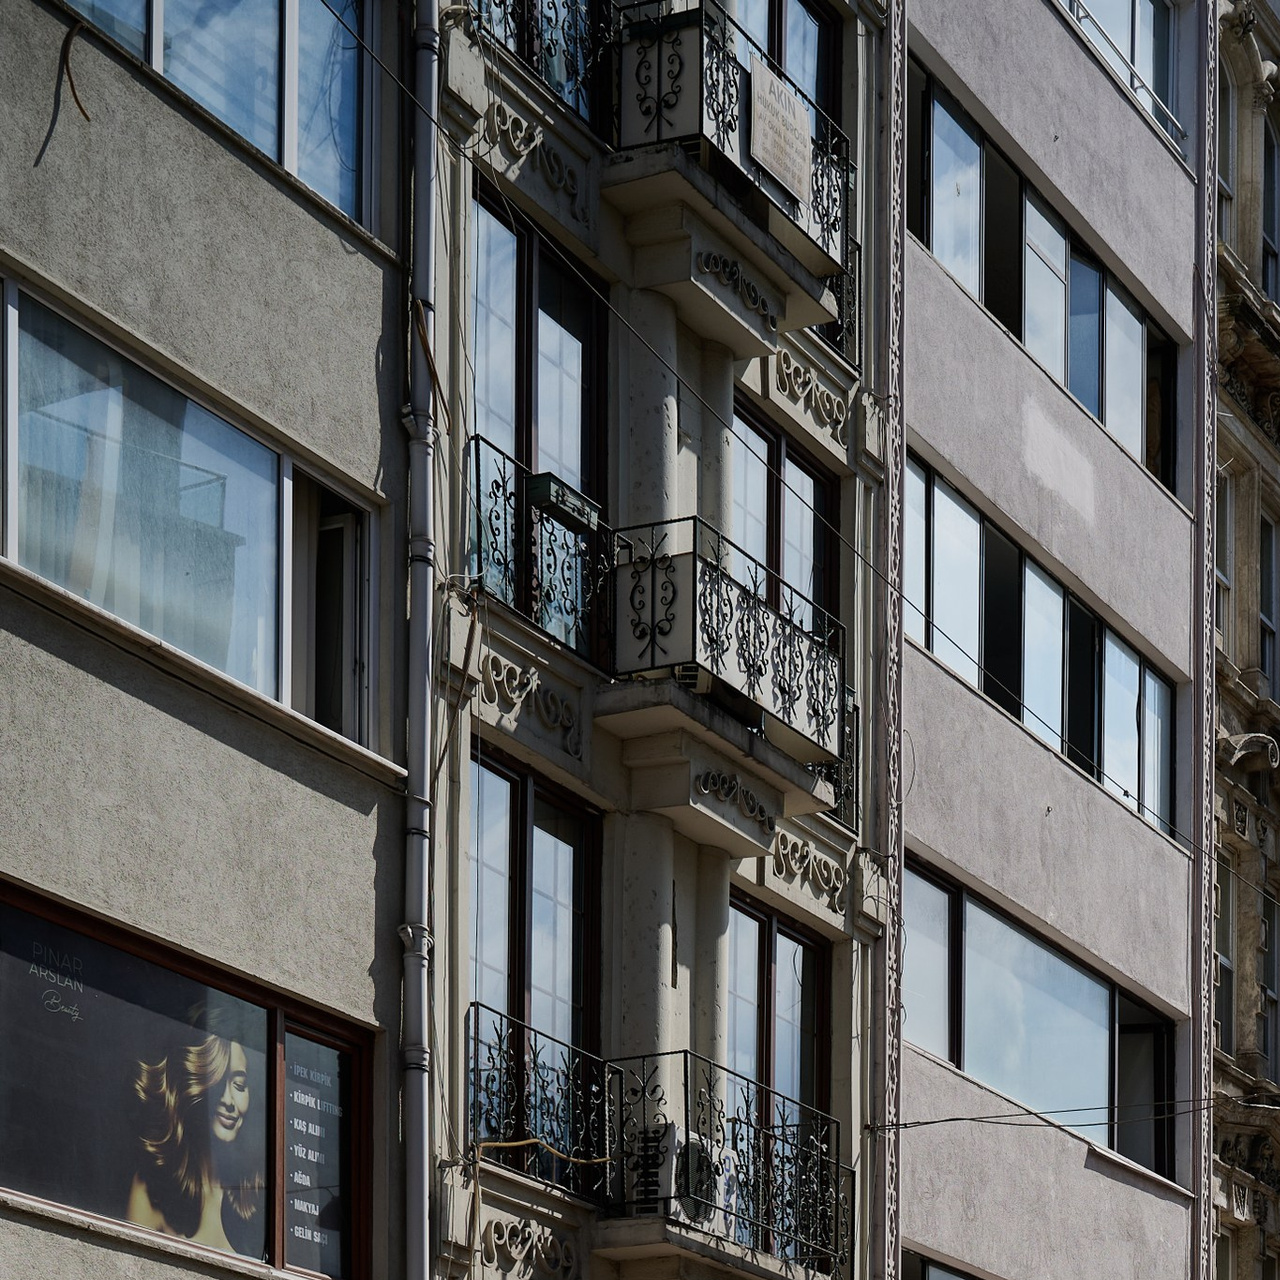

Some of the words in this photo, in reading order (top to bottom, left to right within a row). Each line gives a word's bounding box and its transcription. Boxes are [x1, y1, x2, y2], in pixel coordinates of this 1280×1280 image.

[769, 79, 796, 120] AKIN
[32, 941, 83, 976] PINAR
[29, 963, 83, 993] ARSLAN
[42, 989, 84, 1022] Beauty
[293, 1090, 316, 1109] KİRPİK
[293, 1117, 307, 1135] KAŞ
[293, 1143, 307, 1159] YÜZ
[293, 1170, 311, 1187] AĞDA
[294, 1198, 319, 1216] MAKYAJ
[294, 1225, 312, 1241] GELİN
